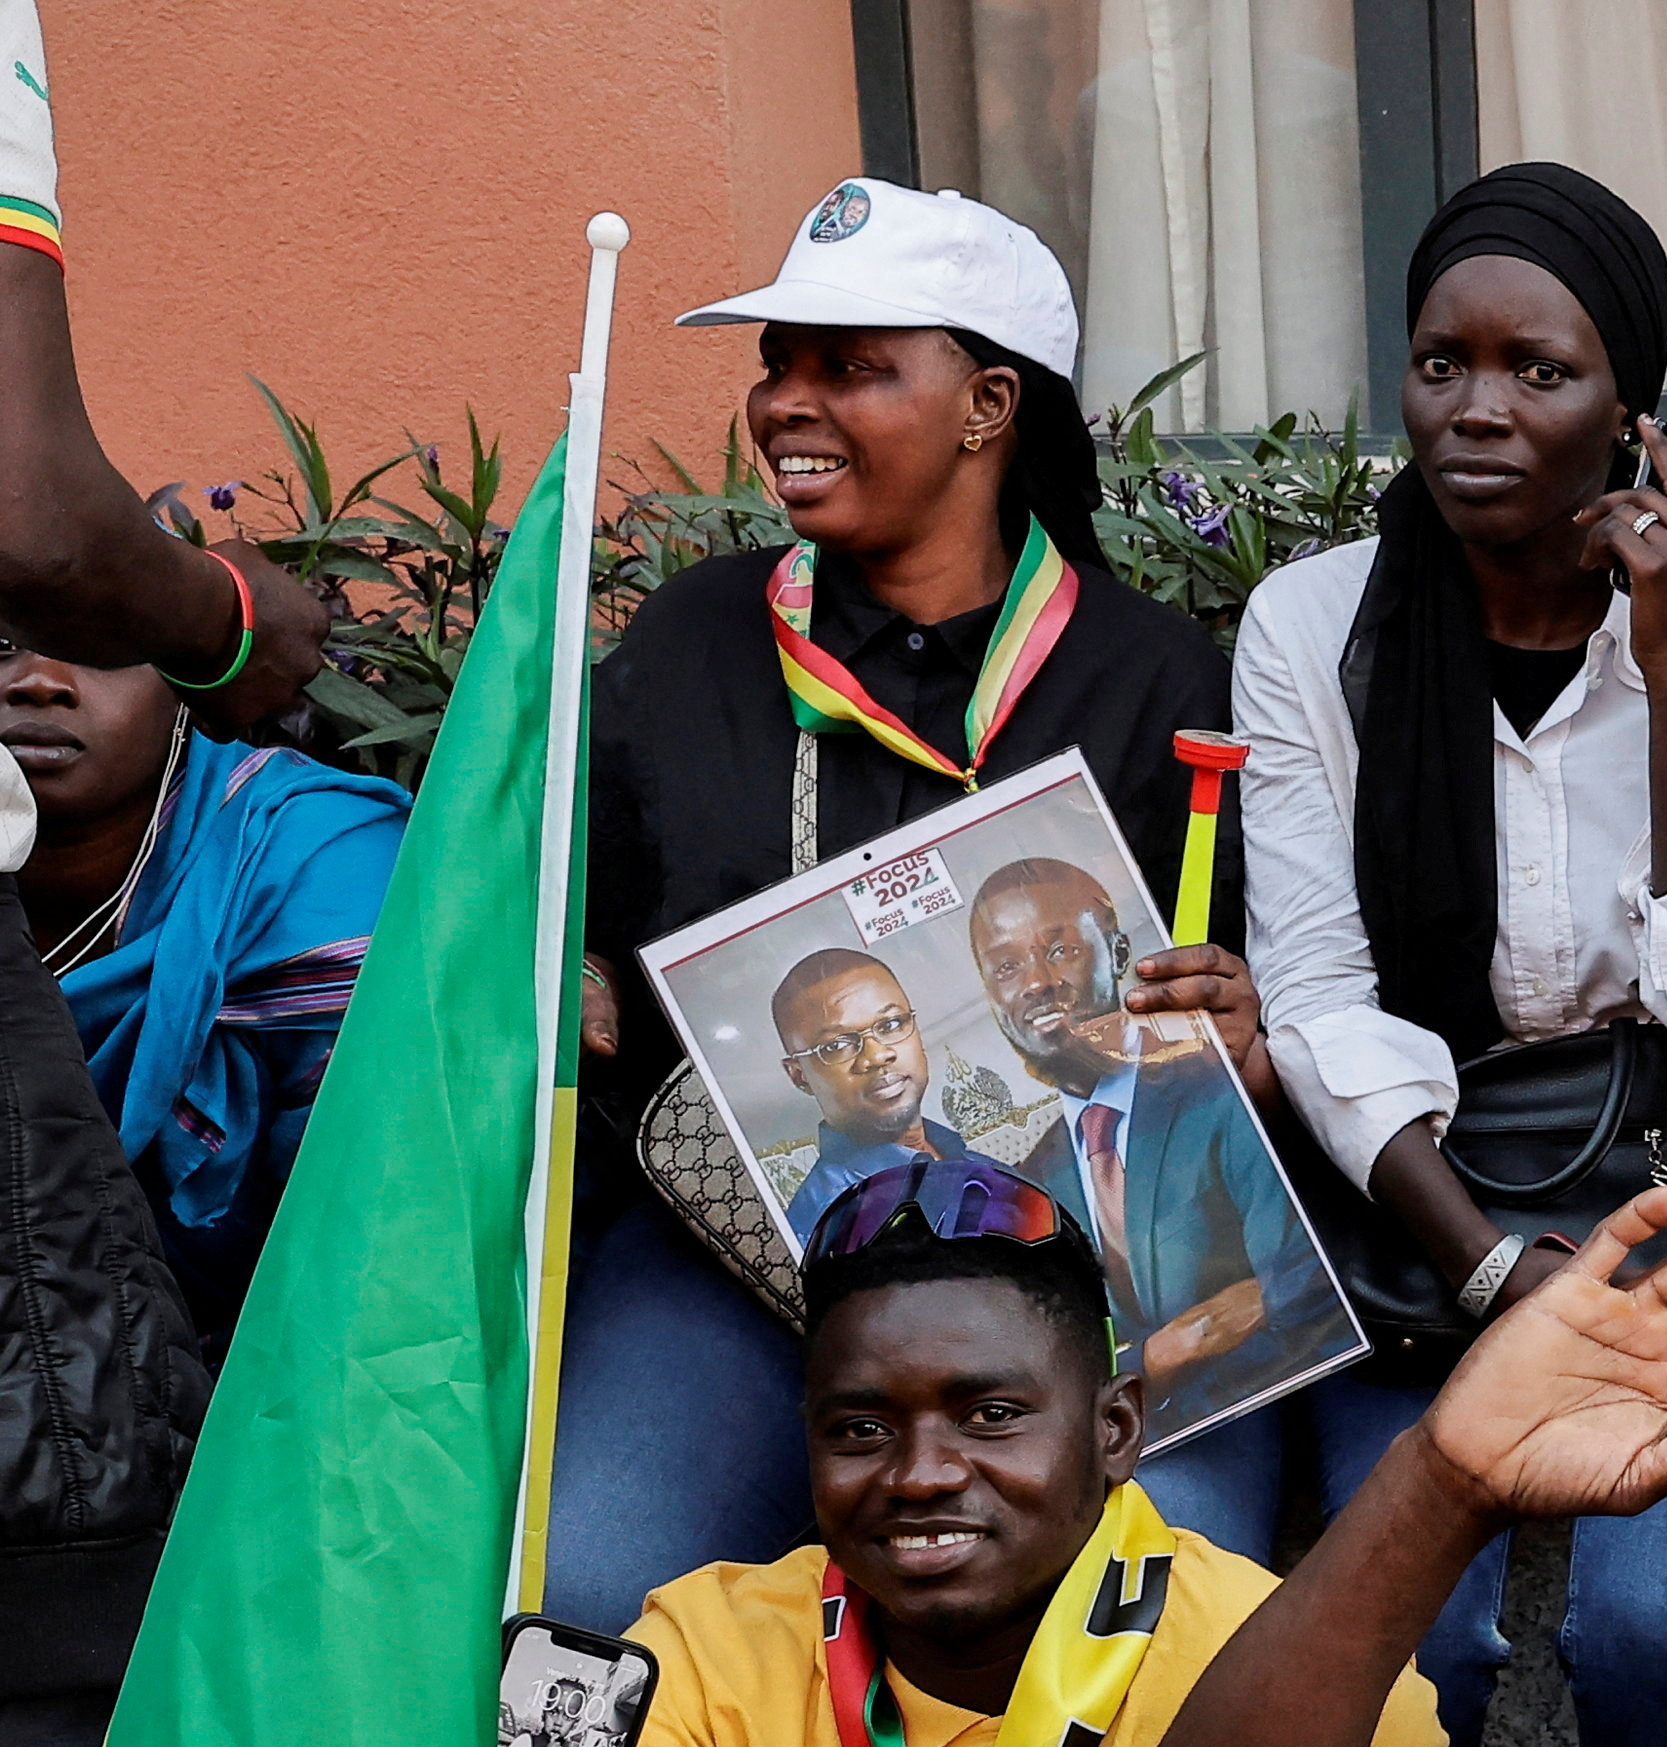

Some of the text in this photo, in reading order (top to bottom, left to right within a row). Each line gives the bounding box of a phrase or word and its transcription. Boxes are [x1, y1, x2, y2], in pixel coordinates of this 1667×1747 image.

[851, 852, 930, 897] #Focus
[874, 866, 940, 908] 2024
[923, 893, 957, 915] 2024
[876, 915, 909, 937] 2024
[530, 1679, 607, 1724] 19:00
